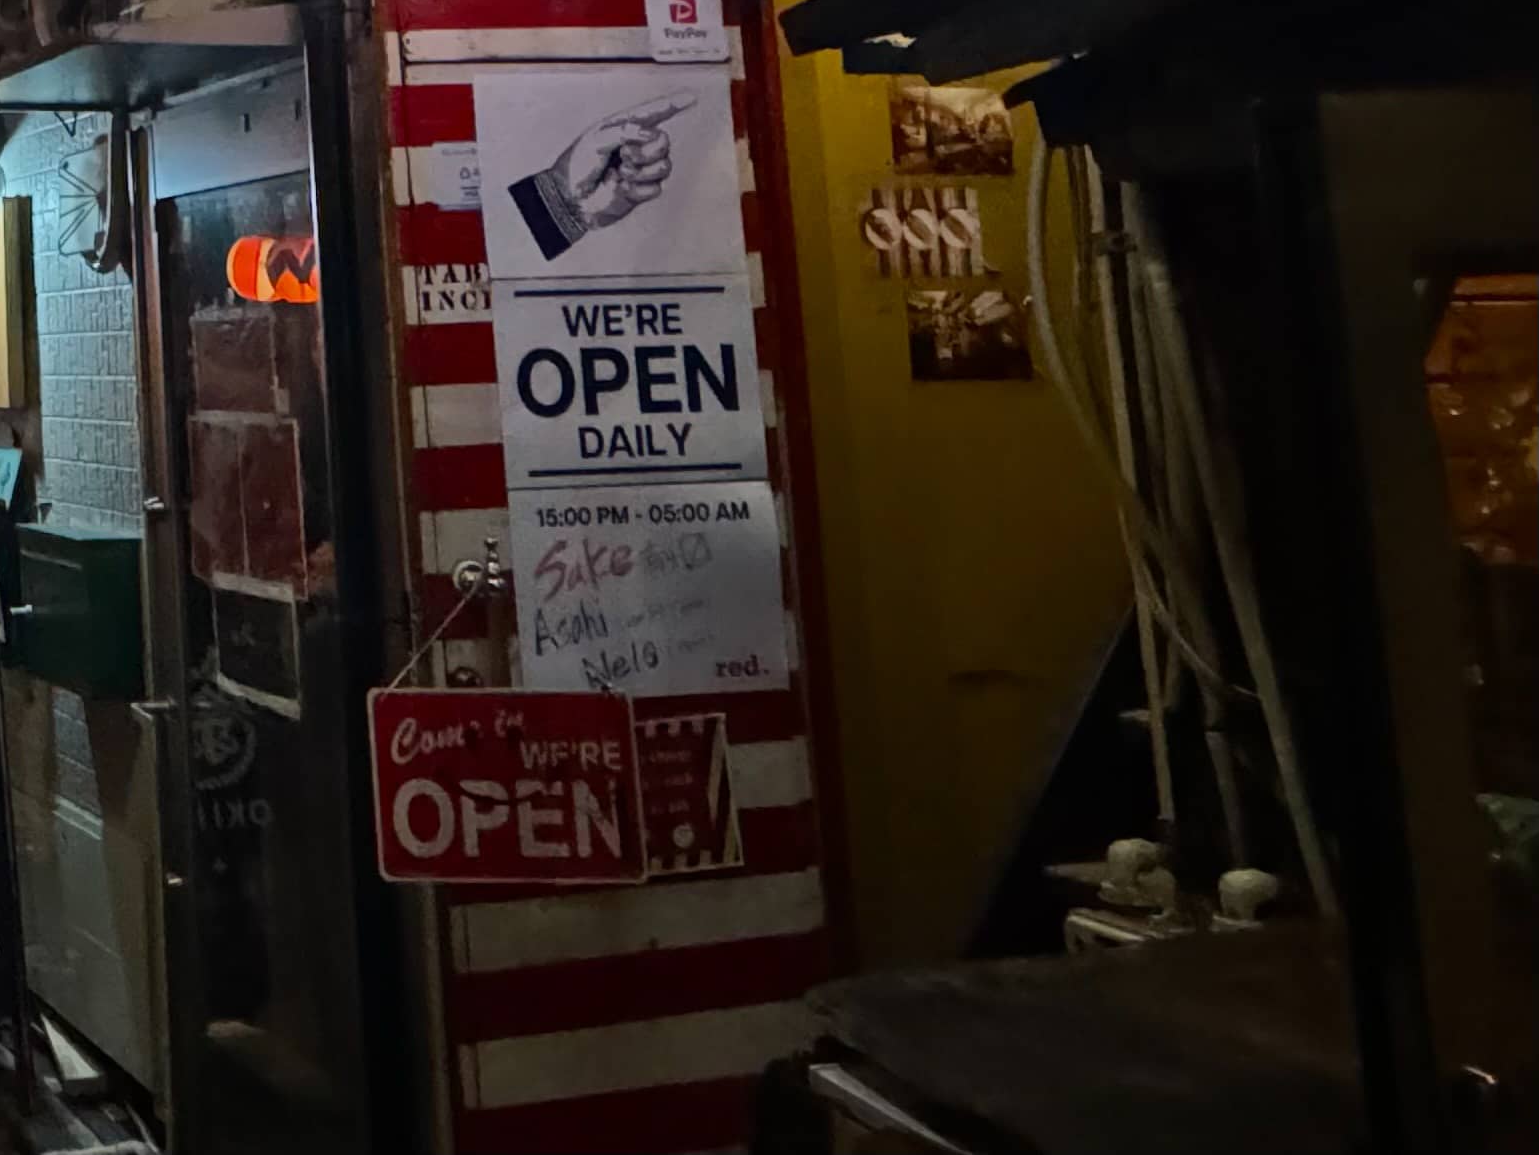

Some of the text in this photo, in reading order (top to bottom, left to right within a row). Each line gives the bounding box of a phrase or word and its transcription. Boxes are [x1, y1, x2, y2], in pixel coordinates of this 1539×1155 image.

[664, 27, 708, 39] PayPay
[562, 303, 683, 338] WE'RE
[517, 343, 741, 418] OPEN
[578, 422, 693, 460] DAILY
[536, 507, 592, 528] 15:00
[596, 506, 630, 525] PM
[648, 504, 710, 524] 05:00
[715, 501, 751, 521] AM
[534, 599, 608, 657] Asahi
[715, 654, 771, 679] red.
[392, 776, 623, 860] OPEN
